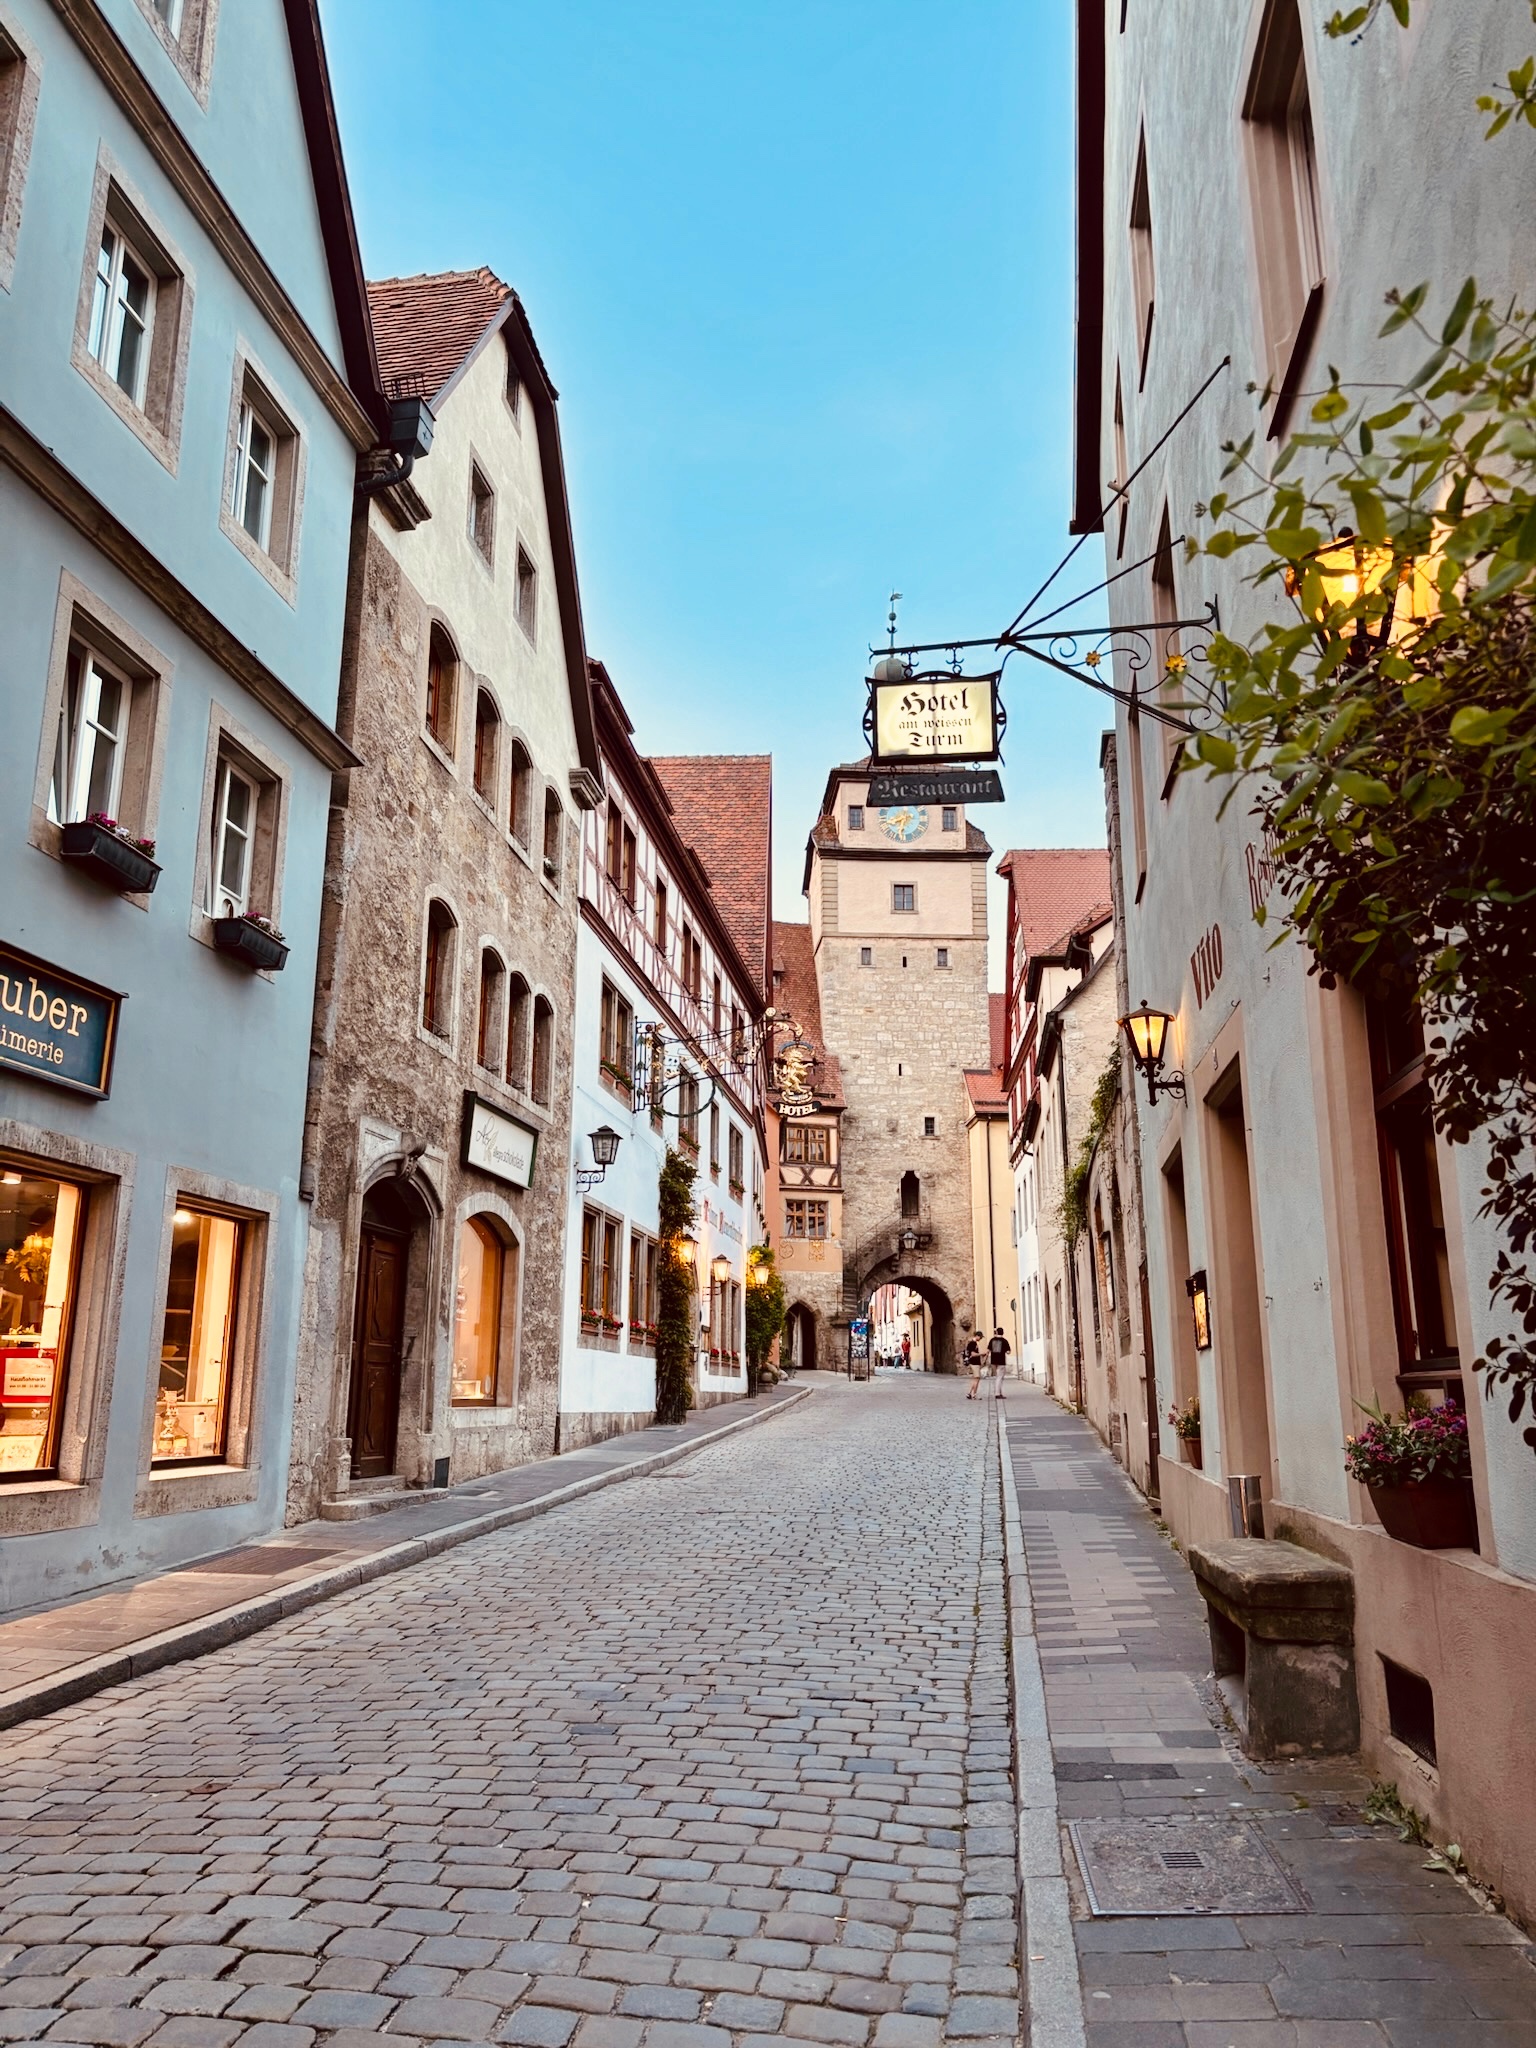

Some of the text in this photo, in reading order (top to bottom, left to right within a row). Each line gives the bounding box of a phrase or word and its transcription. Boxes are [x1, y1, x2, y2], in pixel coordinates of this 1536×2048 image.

[900, 687, 969, 716] Hotel
[899, 716, 972, 729] am weissen
[909, 732, 963, 747] Turm
[878, 779, 993, 798] Restaurant
[779, 1103, 817, 1117] HOTEL
